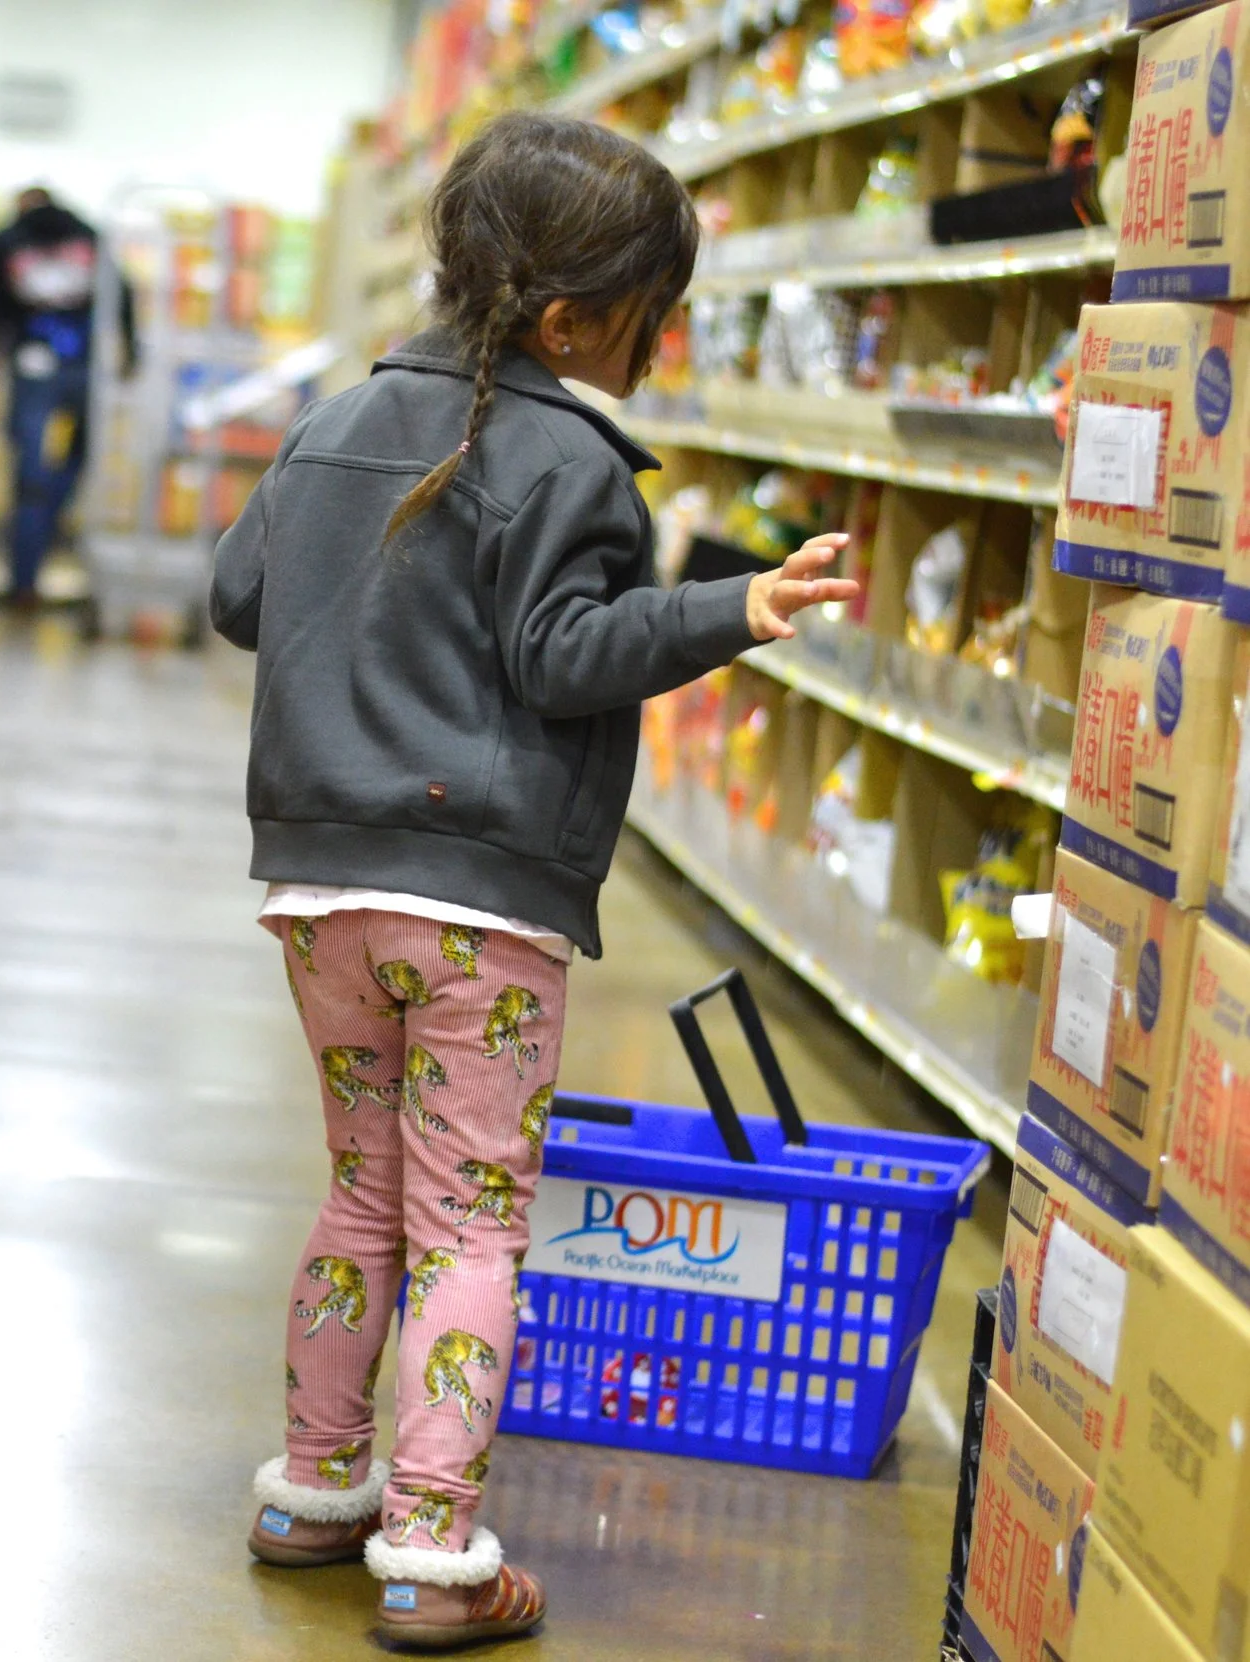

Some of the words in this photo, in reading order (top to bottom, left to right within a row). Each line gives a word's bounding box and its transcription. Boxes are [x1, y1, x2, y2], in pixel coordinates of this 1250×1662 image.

[563, 1248, 603, 1270] Pacific
[606, 1255, 651, 1273] Ocean
[655, 1258, 741, 1286] Marketplace
